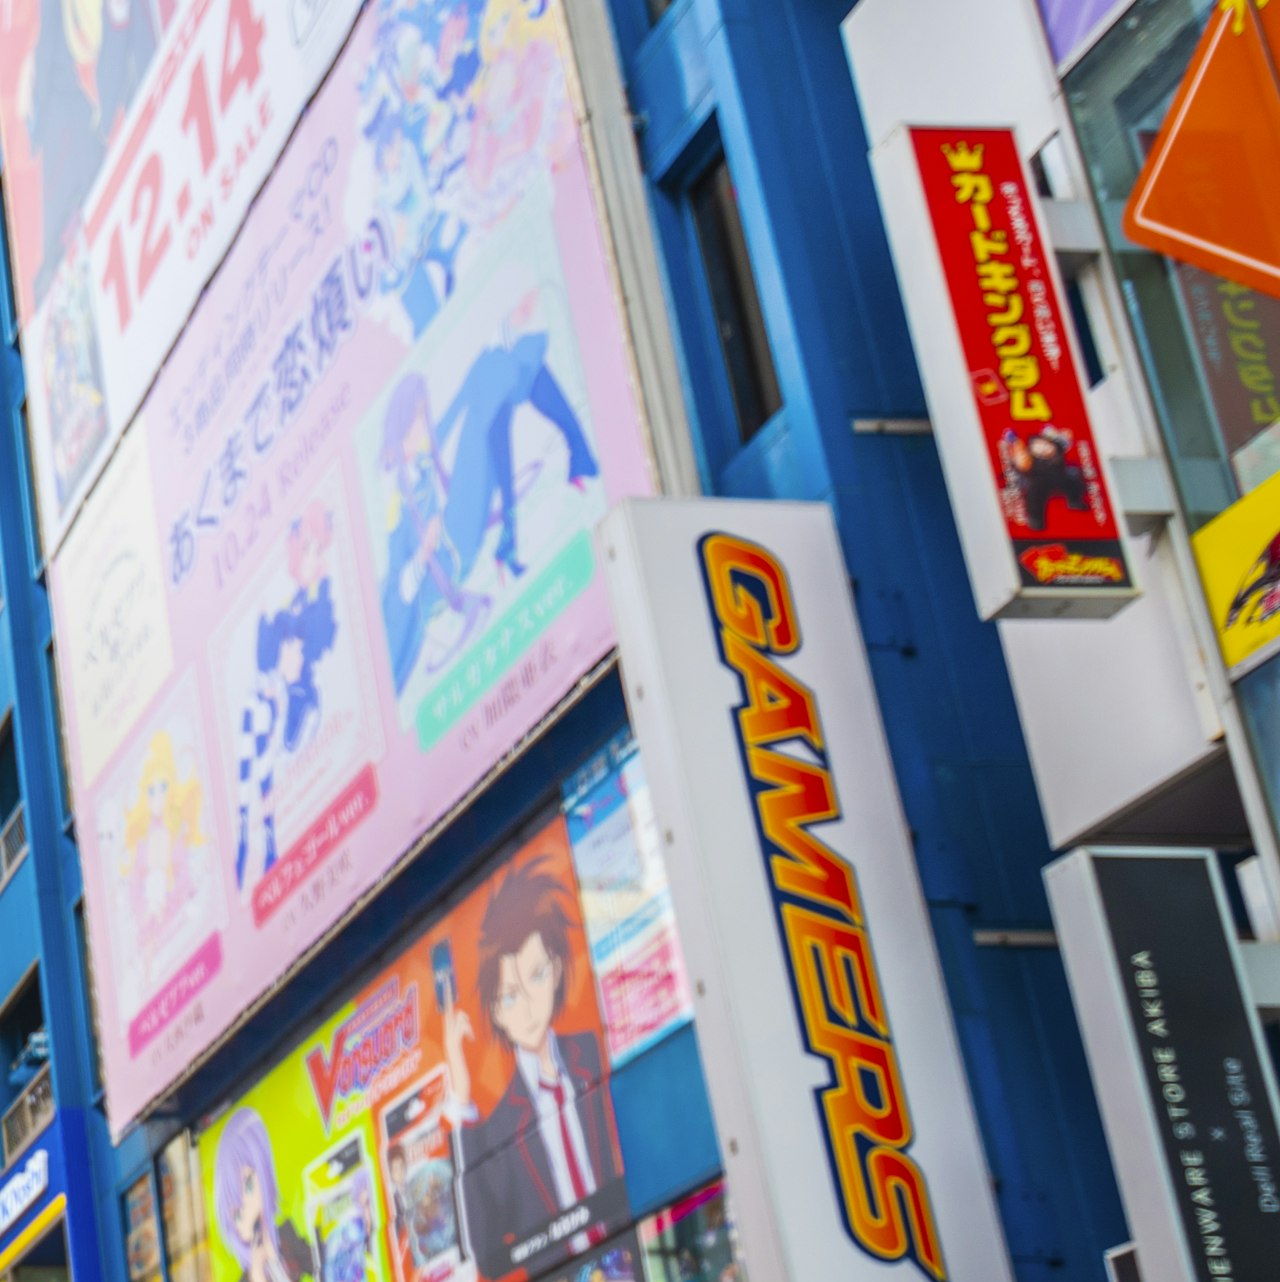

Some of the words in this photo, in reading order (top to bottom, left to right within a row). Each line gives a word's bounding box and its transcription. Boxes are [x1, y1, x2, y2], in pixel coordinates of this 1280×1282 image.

[951, 173, 1052, 421] カードキングダム
[1130, 949, 1170, 1038] AKIBA
[1152, 1046, 1196, 1140] STORE
